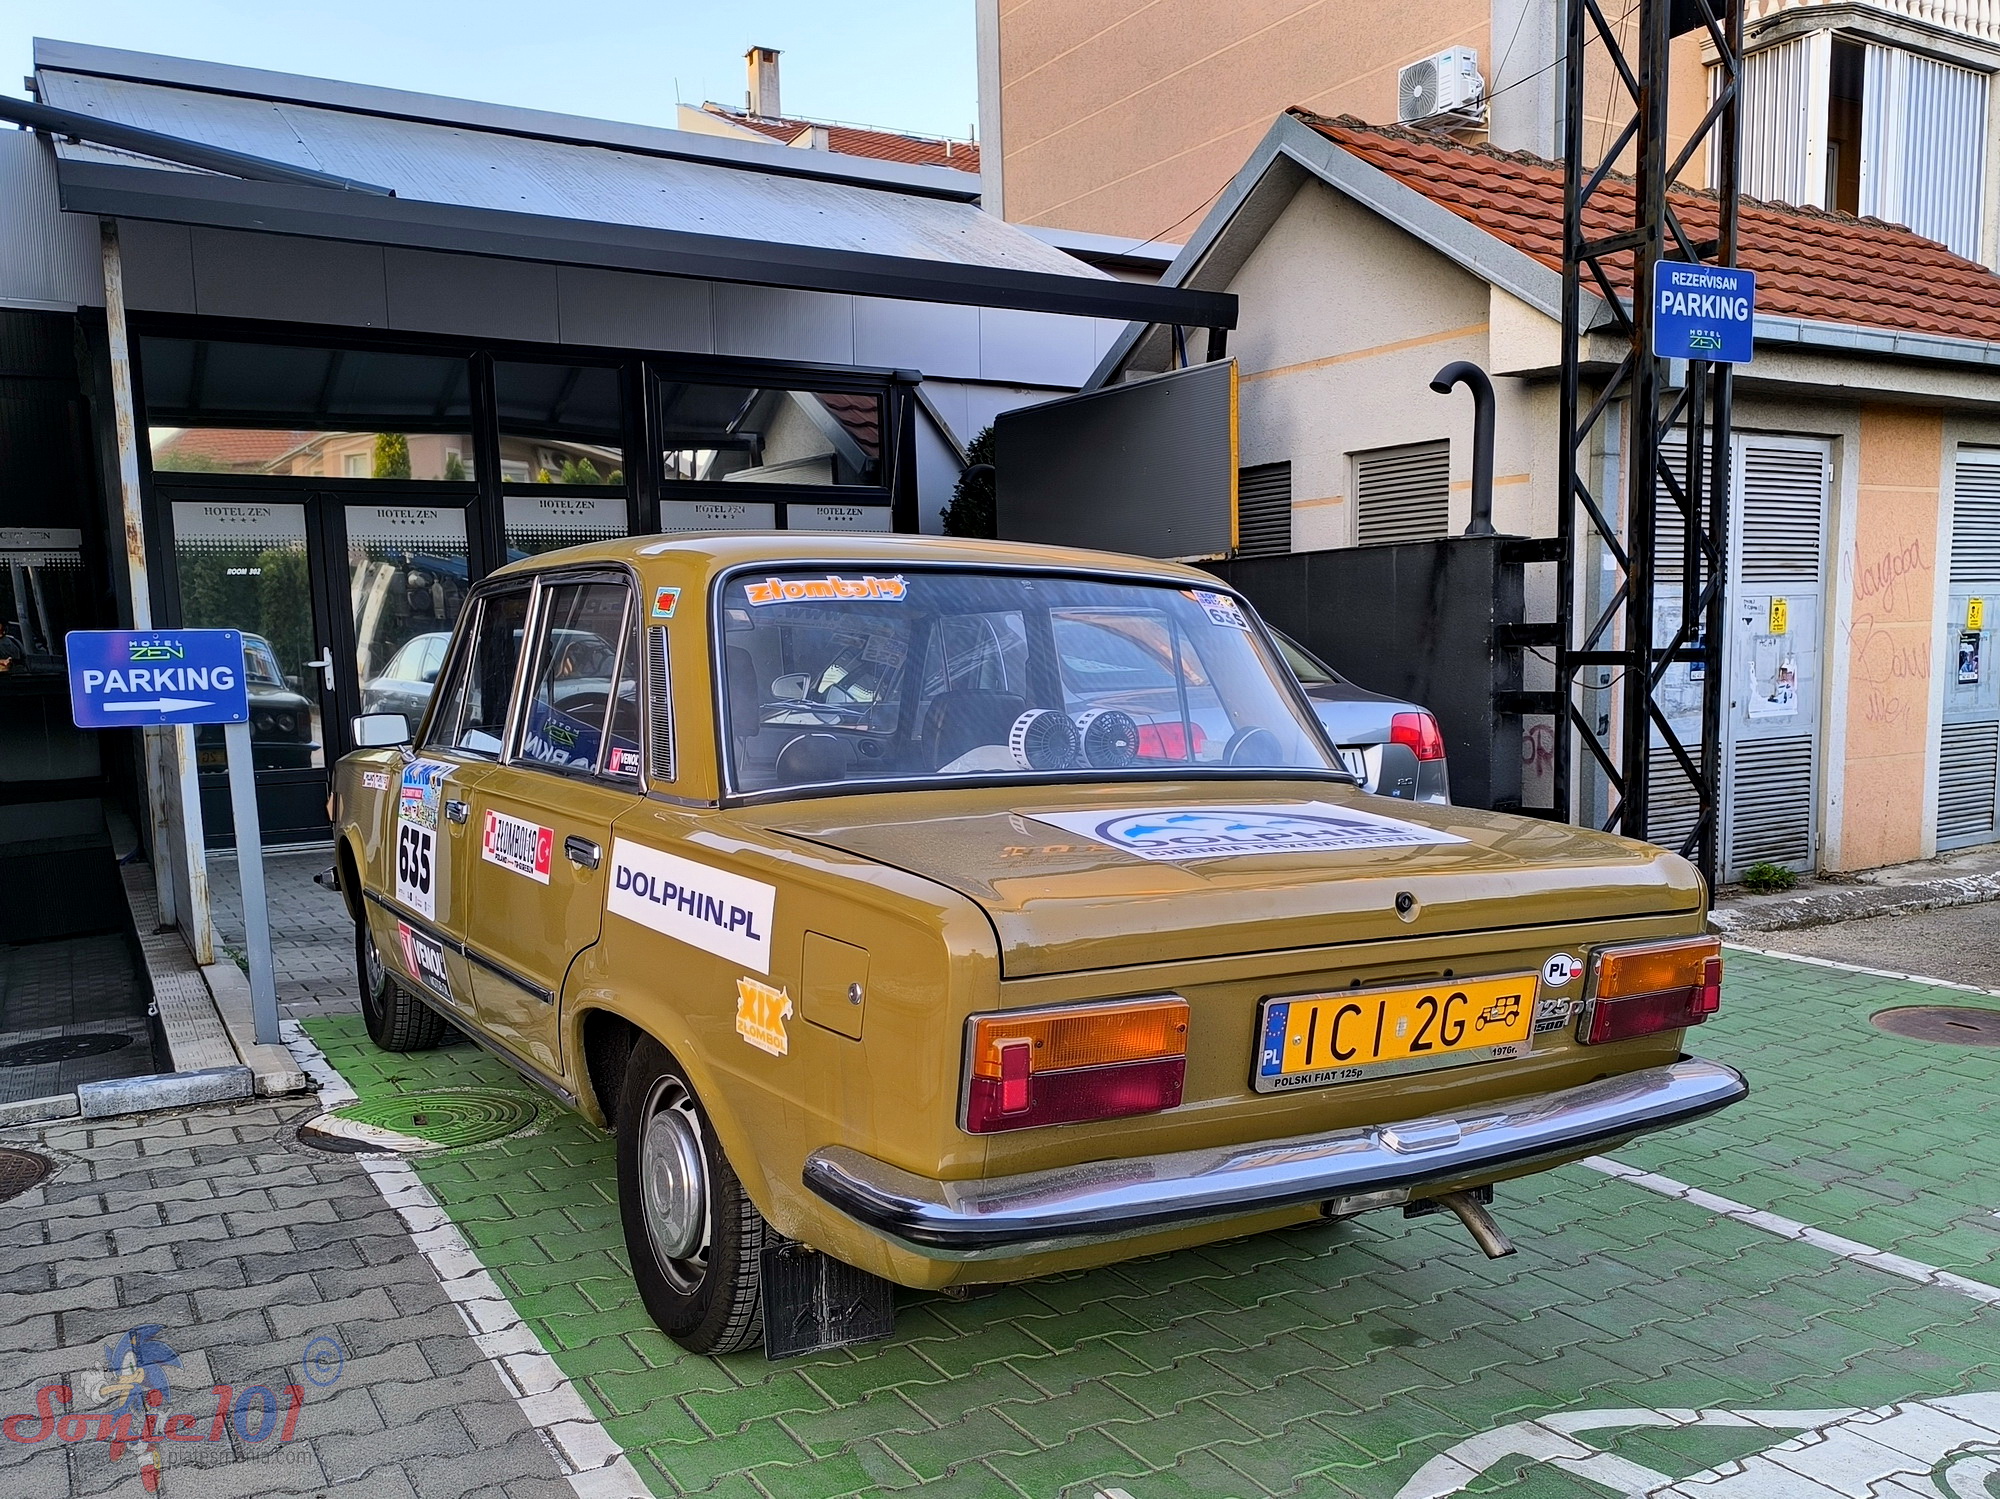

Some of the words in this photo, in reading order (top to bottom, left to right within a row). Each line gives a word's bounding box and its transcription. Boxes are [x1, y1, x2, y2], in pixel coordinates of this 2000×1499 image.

[1671, 271, 1738, 291] REZERVISAN
[1660, 290, 1749, 322] PARKING
[1689, 329, 1721, 338] HOTEL
[1689, 336, 1721, 350] ZEN
[204, 507, 245, 517] HOTEL
[247, 507, 271, 517] ZEN
[539, 500, 571, 509] HOTEL
[574, 501, 595, 510] ZEN
[695, 504, 725, 514] HOTEL
[816, 507, 846, 516] HOTEL
[847, 508, 863, 516] ZEN
[377, 509, 414, 518] HOTEL
[416, 510, 438, 519] ZEN
[226, 567, 248, 576] ROOM
[1209, 608, 1247, 628] 635
[128, 646, 185, 661] ZEN
[82, 666, 235, 694] PARKING
[1122, 827, 1407, 849] DOLPHIN
[1144, 845, 1249, 856] CHEMIA
[399, 824, 432, 895] 635
[615, 864, 761, 941] DOLPHIN.PL
[412, 937, 447, 981] VENOL
[1548, 962, 1568, 978] PL
[739, 982, 787, 1038] XIX
[1408, 991, 1469, 1053] 2G
[1534, 1020, 1564, 1033] 500
[1262, 1048, 1281, 1067] PL
[1491, 1046, 1518, 1057] 1976r.
[1274, 1074, 1313, 1088] POLSKI
[1314, 1071, 1338, 1083] FIAT
[1340, 1068, 1363, 1081] 125p
